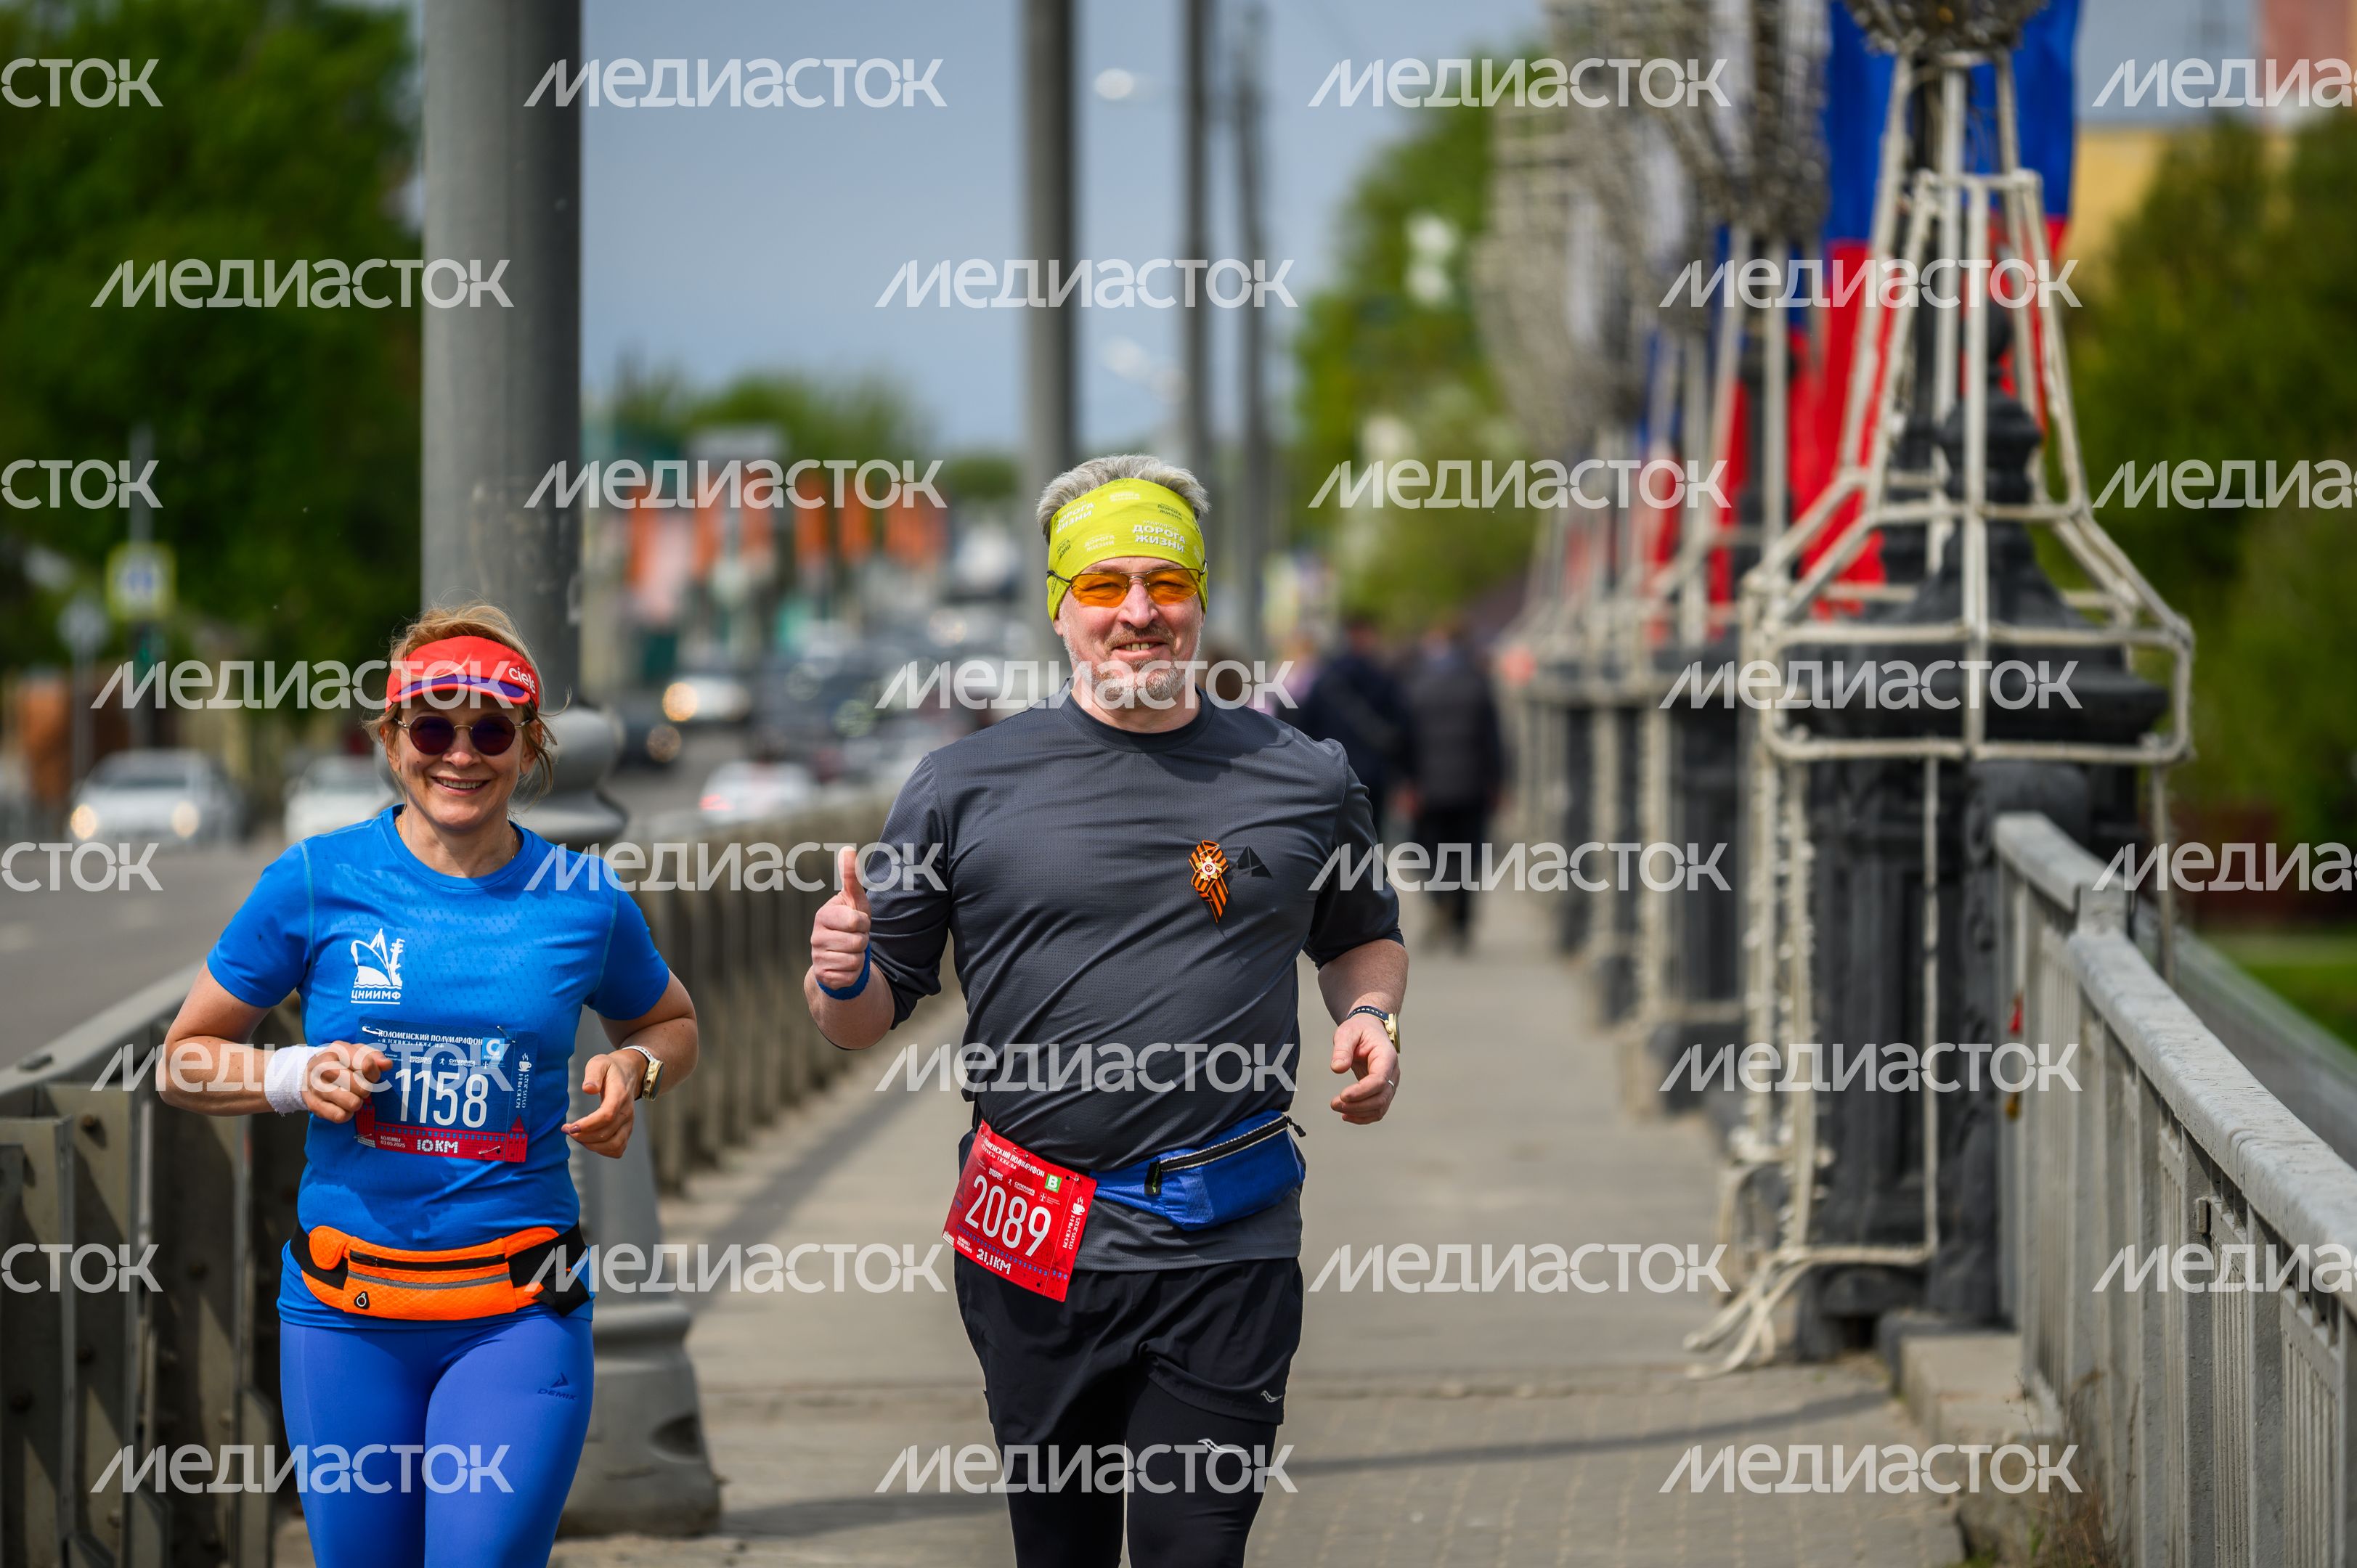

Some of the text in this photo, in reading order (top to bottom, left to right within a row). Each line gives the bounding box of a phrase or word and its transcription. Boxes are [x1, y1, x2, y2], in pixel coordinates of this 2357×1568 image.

[1132, 524, 1186, 544] ДОРОГА
[1135, 534, 1185, 553] ЖИЗНИ
[508, 666, 536, 695] ciele
[351, 989, 402, 1000] ЦНИИМФ
[378, 1030, 430, 1042] КОЛОМЕНСКИЙ
[431, 1034, 483, 1045] ПОЛУМАРАФОН
[395, 1068, 489, 1127] 1158
[964, 1175, 1051, 1257] 2089
[537, 1388, 577, 1400] DEMIX
